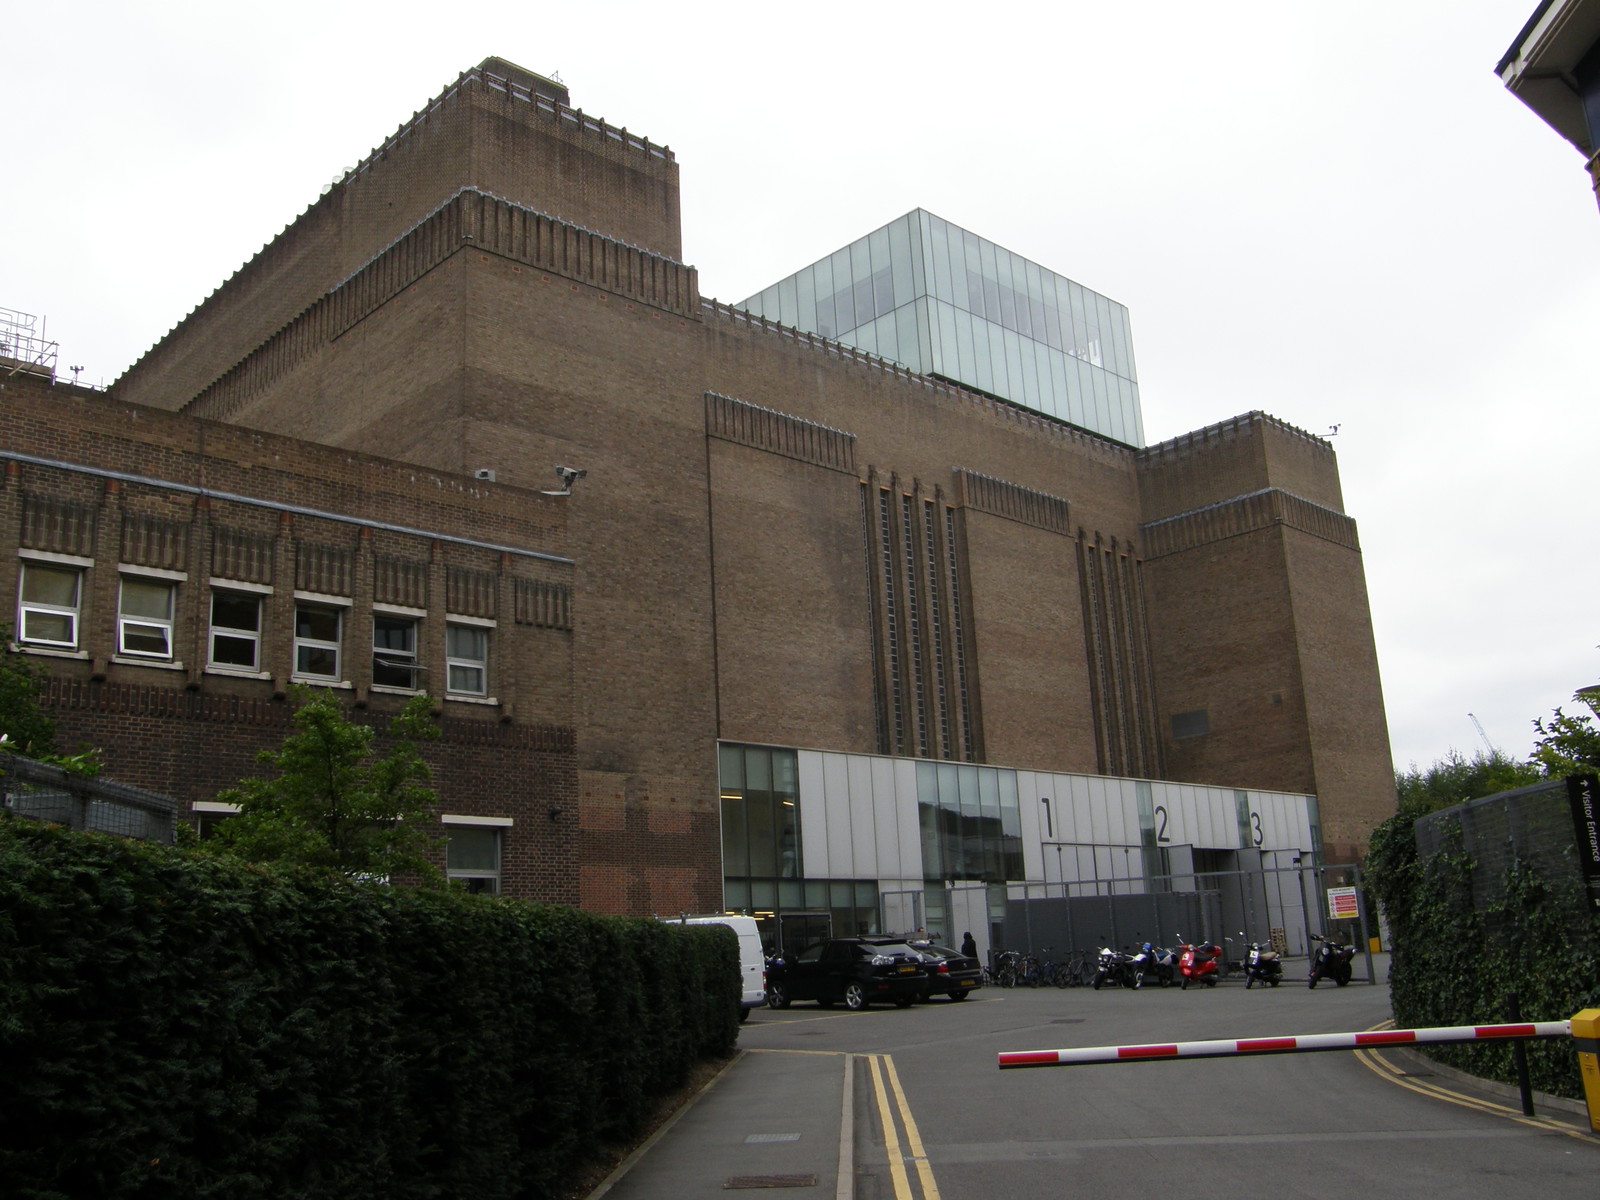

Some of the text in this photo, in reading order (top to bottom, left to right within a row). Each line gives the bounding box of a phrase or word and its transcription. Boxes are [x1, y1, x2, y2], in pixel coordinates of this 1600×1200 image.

[1041, 798, 1052, 838] 1
[1582, 790, 1593, 819] Visitor
[1155, 806, 1170, 842] 2
[1251, 812, 1264, 846] 3
[1587, 821, 1600, 862] Entrance
